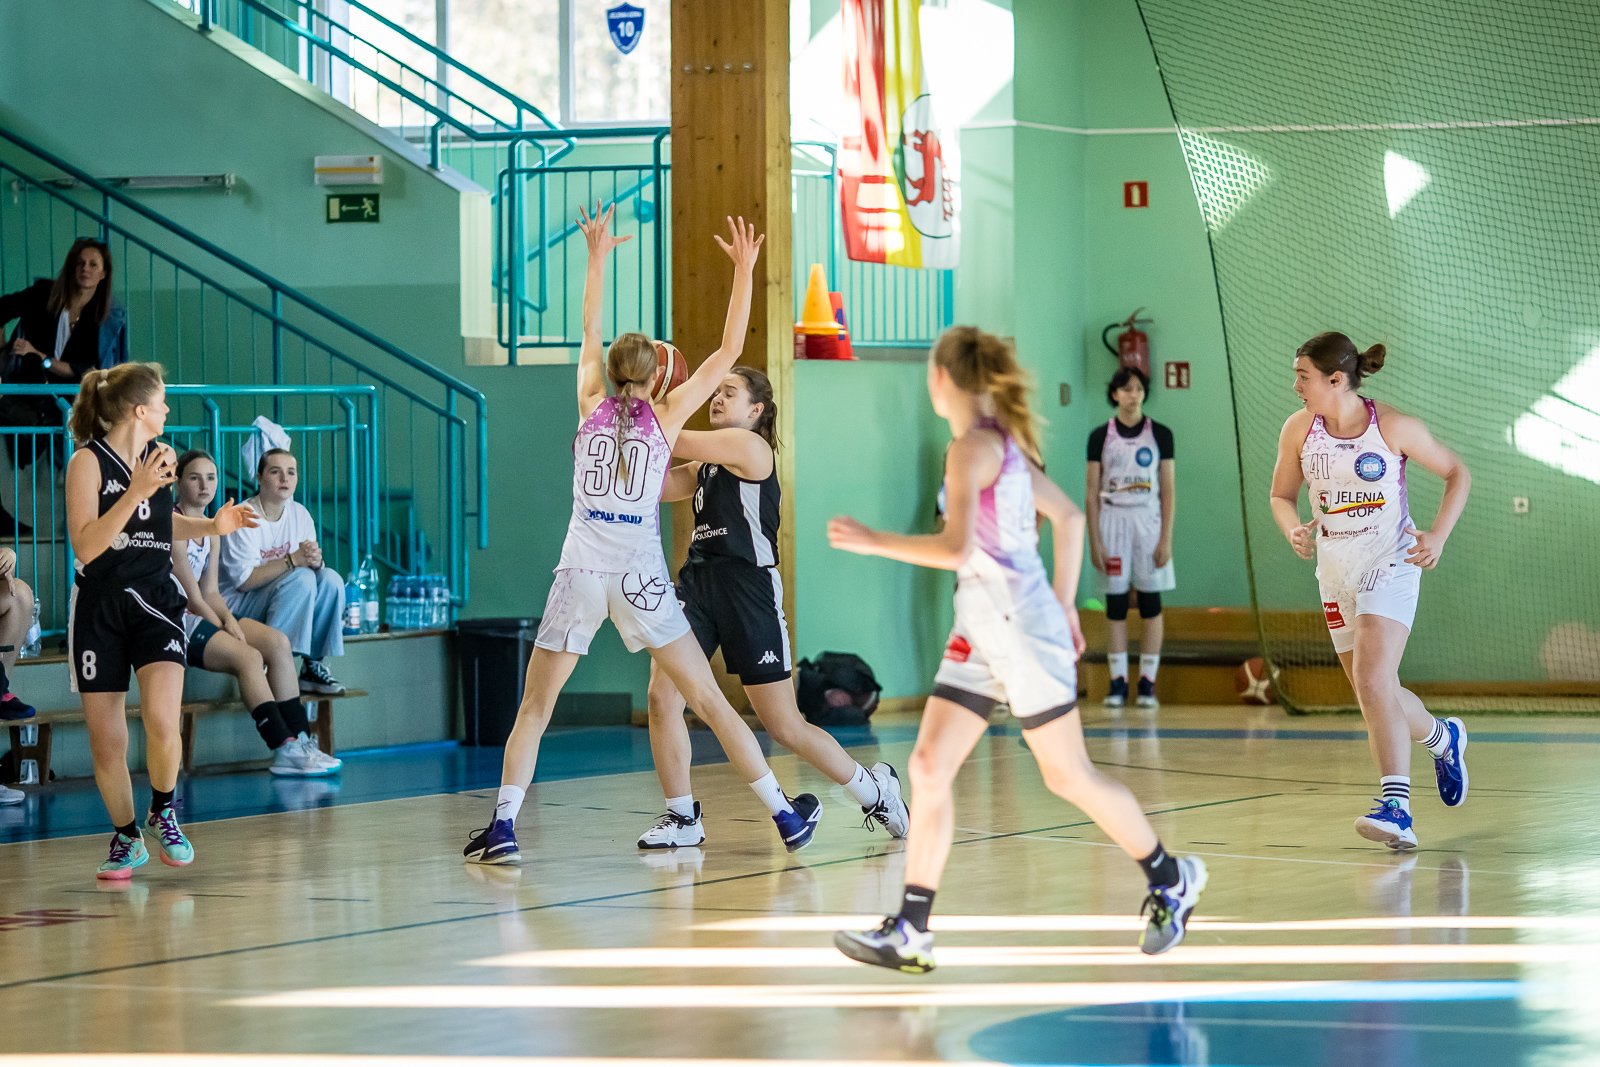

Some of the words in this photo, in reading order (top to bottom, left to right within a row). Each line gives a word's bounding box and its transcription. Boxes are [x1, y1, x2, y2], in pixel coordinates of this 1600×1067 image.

[617, 21, 635, 38] 10
[583, 433, 651, 502] 30
[1310, 453, 1330, 480] 41
[1334, 491, 1385, 504] JELENIA
[138, 498, 151, 520] 8
[128, 539, 171, 551] POLKOWICE
[132, 531, 155, 540] MINA
[82, 650, 97, 680] 8
